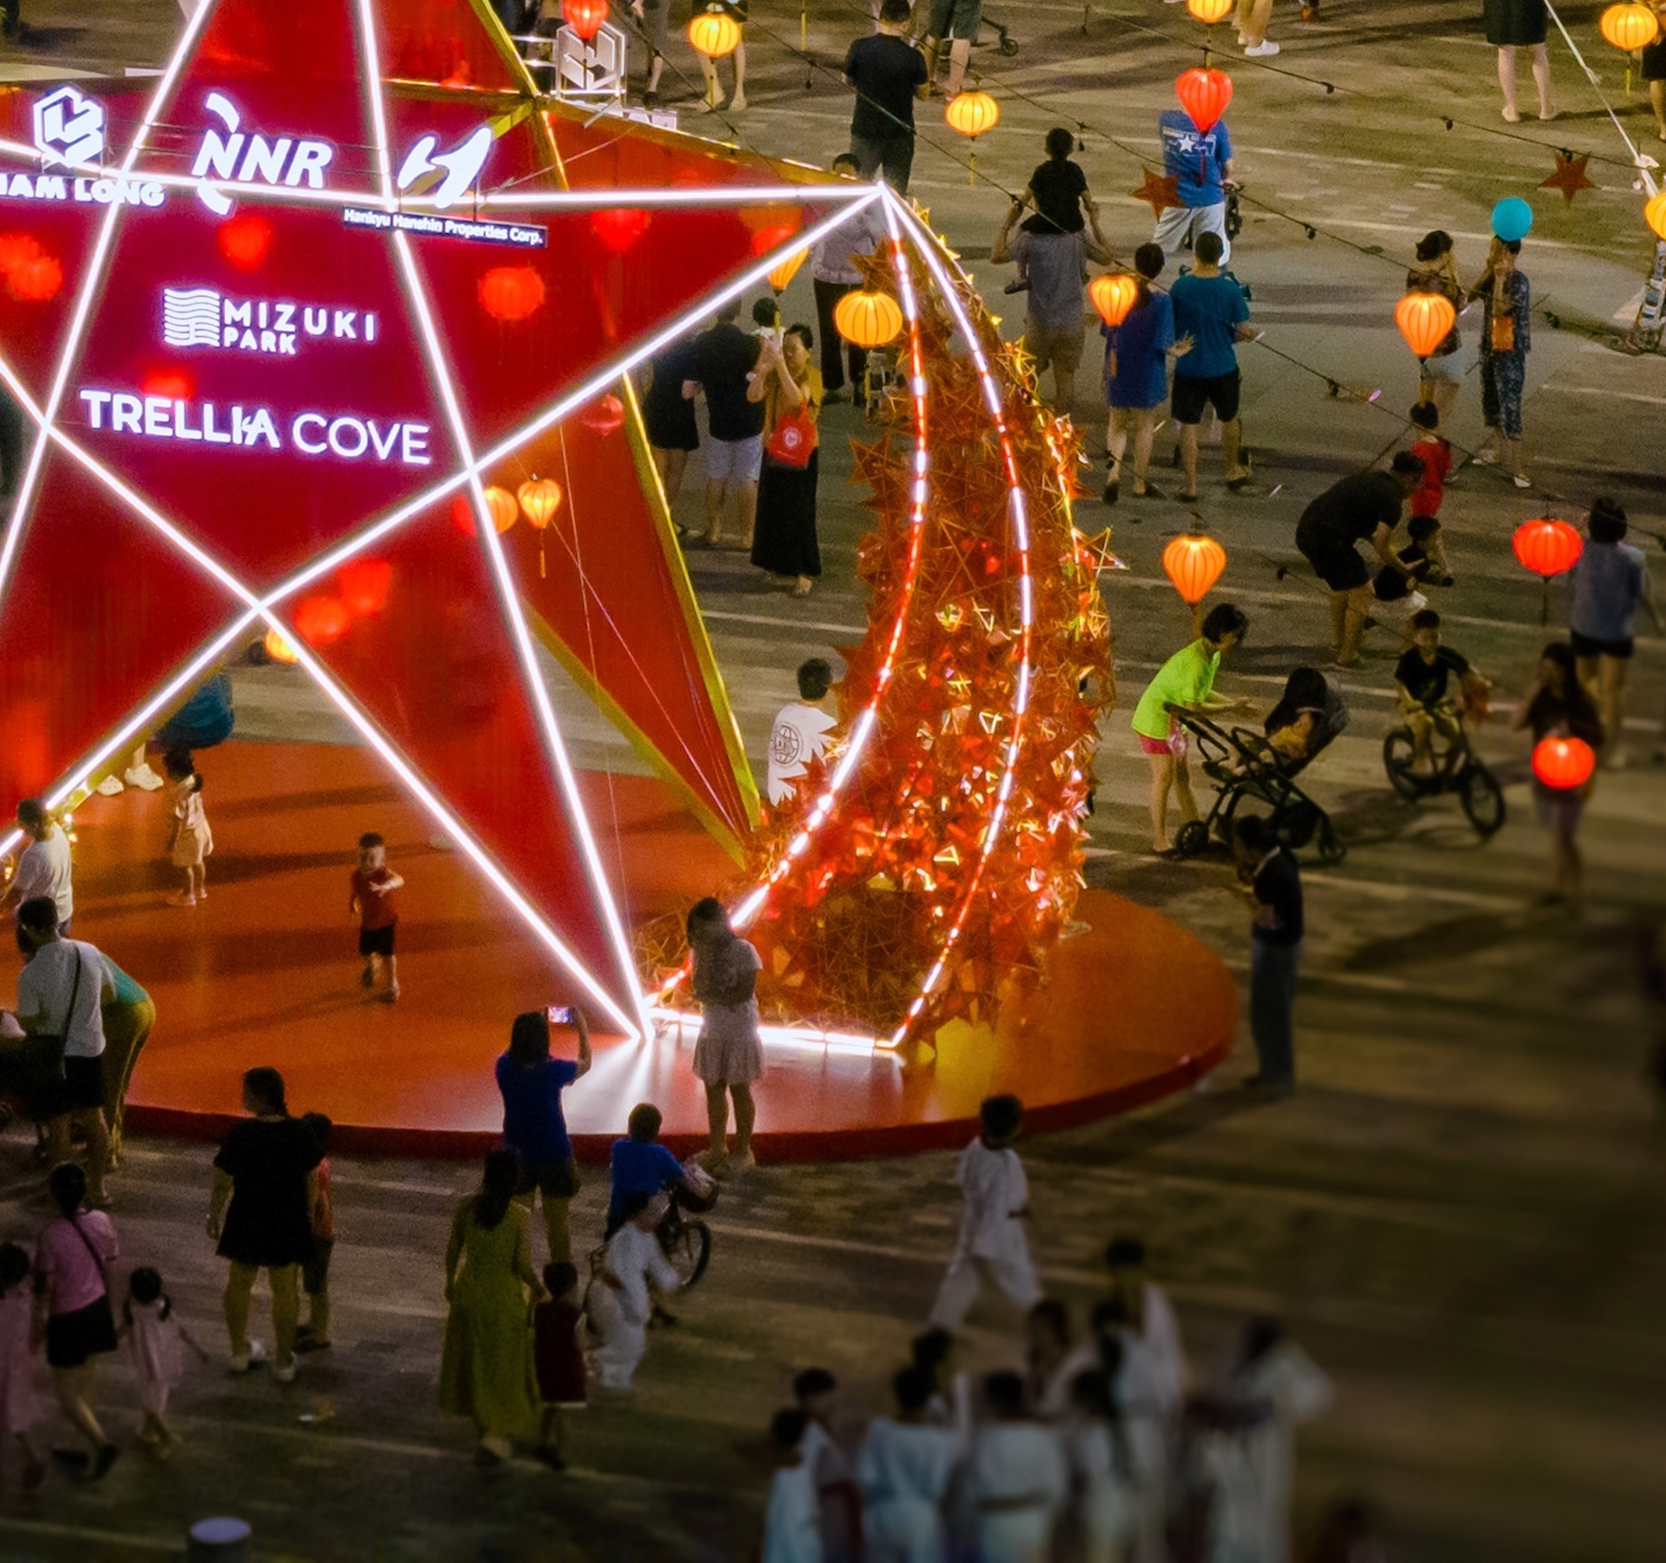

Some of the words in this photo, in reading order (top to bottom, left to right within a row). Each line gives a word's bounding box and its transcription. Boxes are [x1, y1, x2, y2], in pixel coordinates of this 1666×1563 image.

[191, 129, 333, 189] NNR
[75, 179, 164, 206] LONG
[344, 209, 390, 227] Hankyu
[393, 214, 443, 232] Hanshin
[445, 221, 508, 239] Properties
[510, 227, 544, 245] Corp.
[224, 298, 374, 341] MIZUKI
[224, 326, 296, 354] PARK
[80, 390, 281, 448] TRELLIA
[293, 413, 431, 464] COVE
